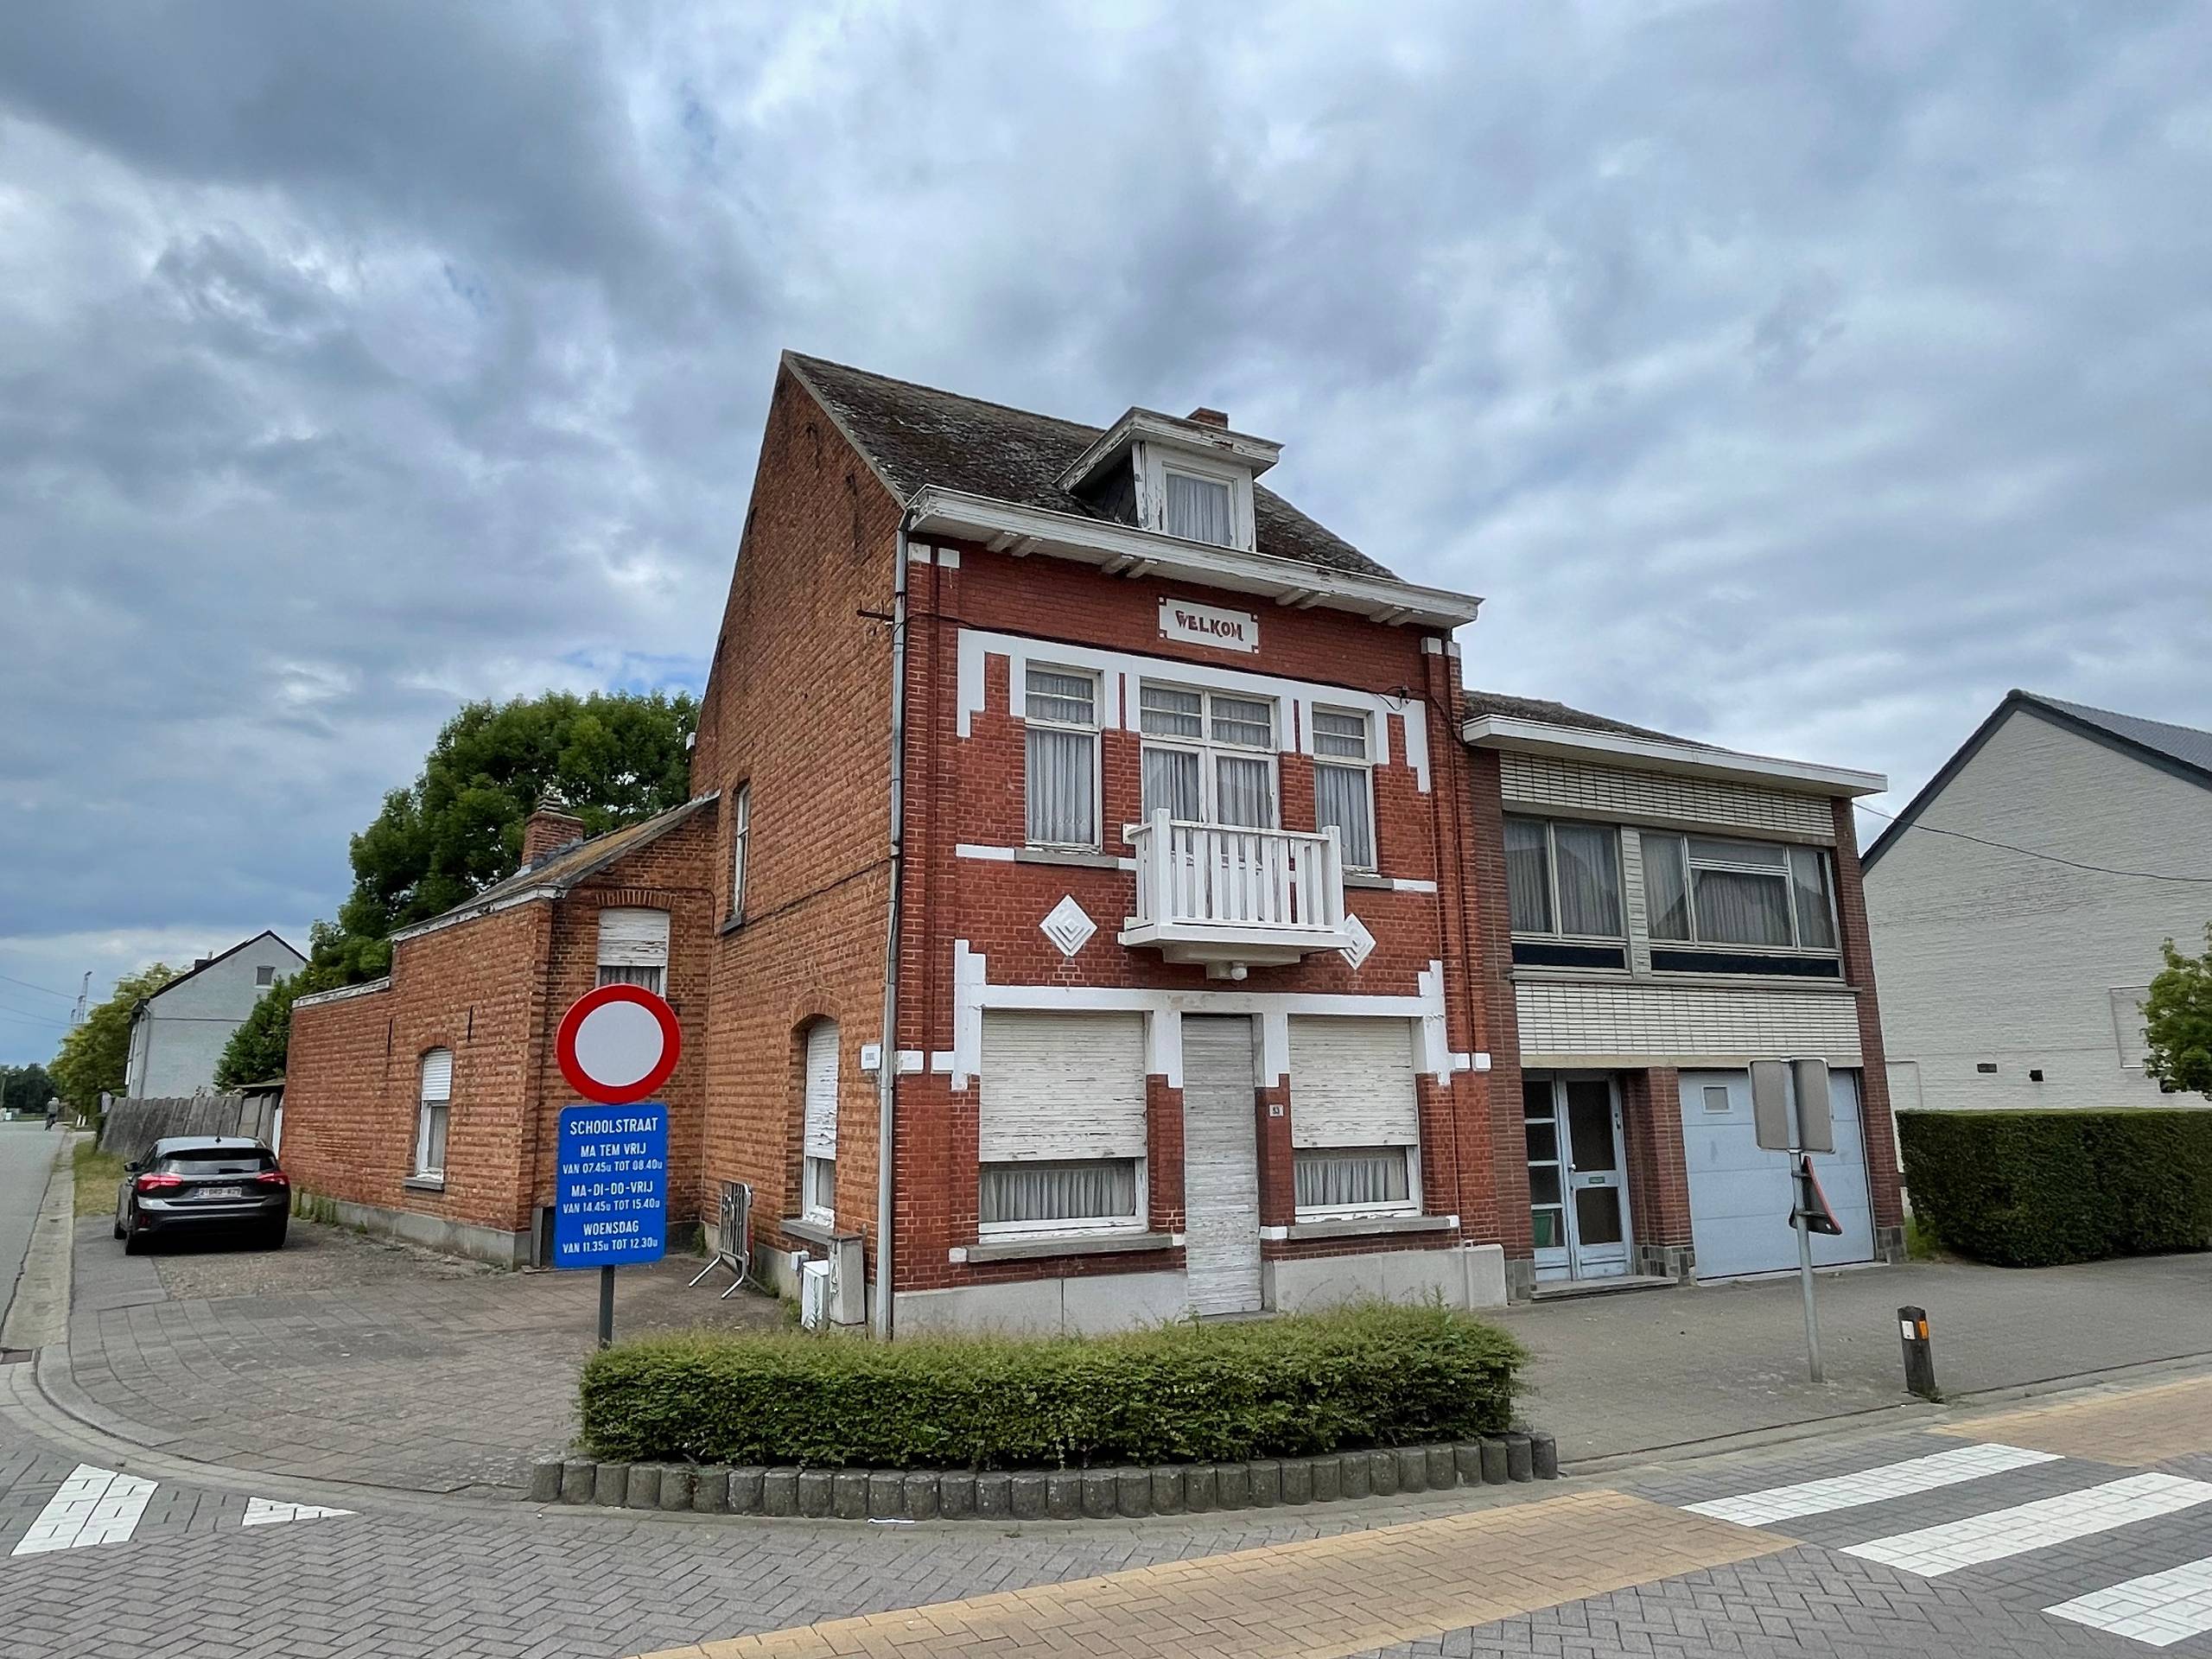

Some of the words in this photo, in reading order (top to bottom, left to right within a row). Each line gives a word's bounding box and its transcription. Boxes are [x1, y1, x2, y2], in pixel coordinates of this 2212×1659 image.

[1175, 609, 1244, 641] WELKOM
[569, 1117, 658, 1135] SCHOOLSTRAAT
[581, 1145, 596, 1158] MA
[600, 1143, 620, 1157] TEM
[624, 1142, 646, 1155] VRIJ
[563, 1163, 580, 1174] VAN
[614, 1160, 630, 1172] TOT
[563, 1203, 580, 1214] VAN
[613, 1199, 630, 1211] TOT
[583, 1220, 639, 1236] WOENSDAG
[563, 1243, 580, 1254] VAN
[612, 1239, 628, 1250] TOT
